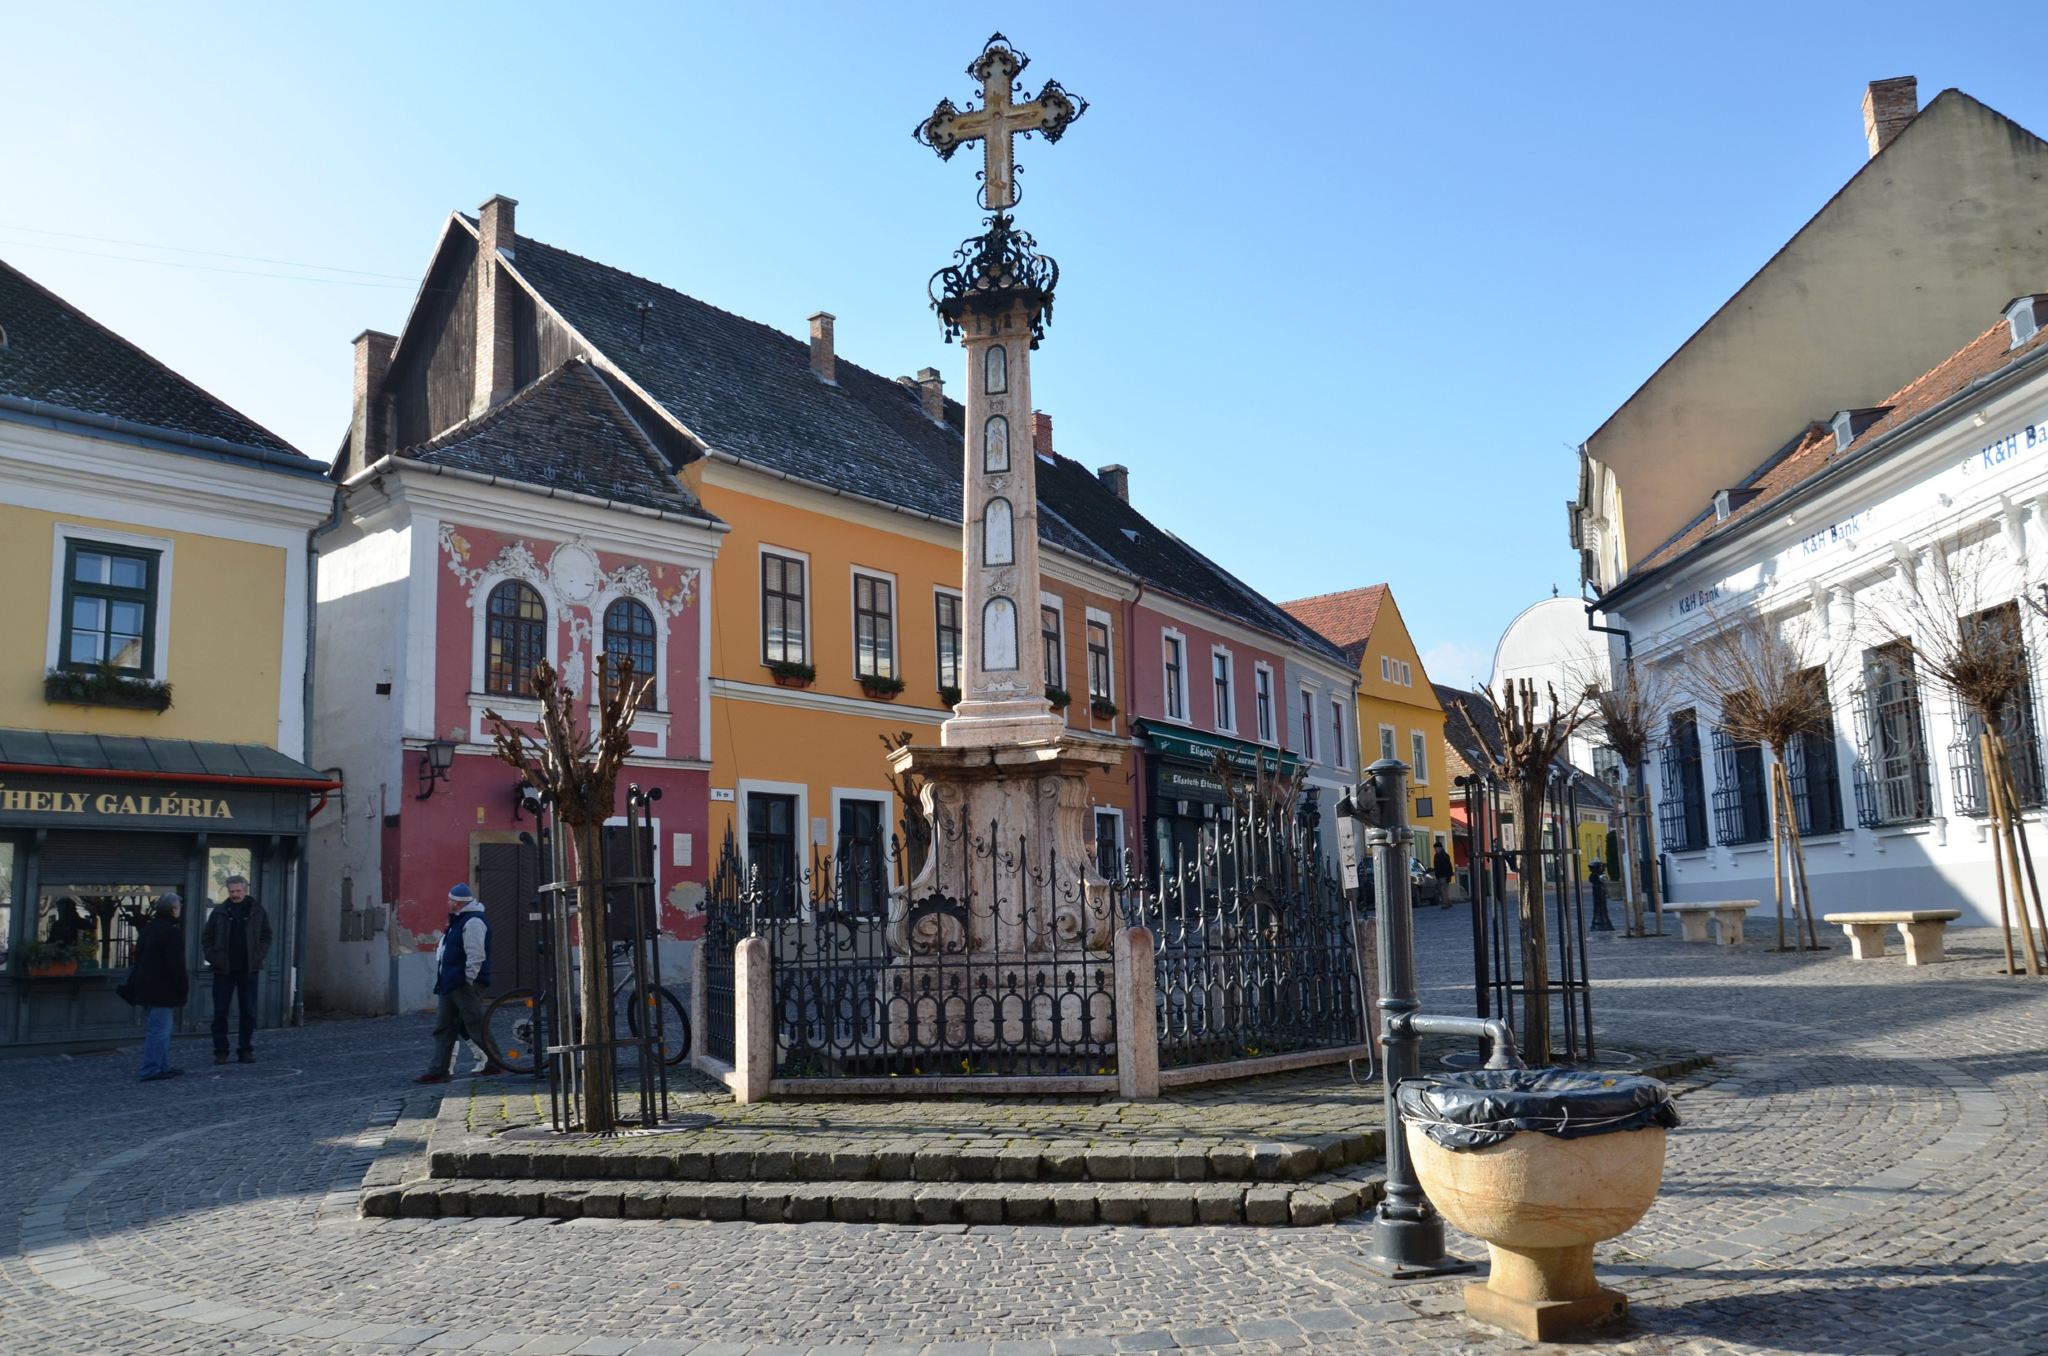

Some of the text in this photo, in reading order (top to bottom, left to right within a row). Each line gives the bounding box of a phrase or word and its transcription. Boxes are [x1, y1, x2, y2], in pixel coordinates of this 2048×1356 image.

[1982, 432, 2018, 470] K&H
[1801, 514, 1860, 557] K&H Bank
[1679, 583, 1720, 616] K&H Bank
[0, 783, 234, 819] HELY GALÉRIA
